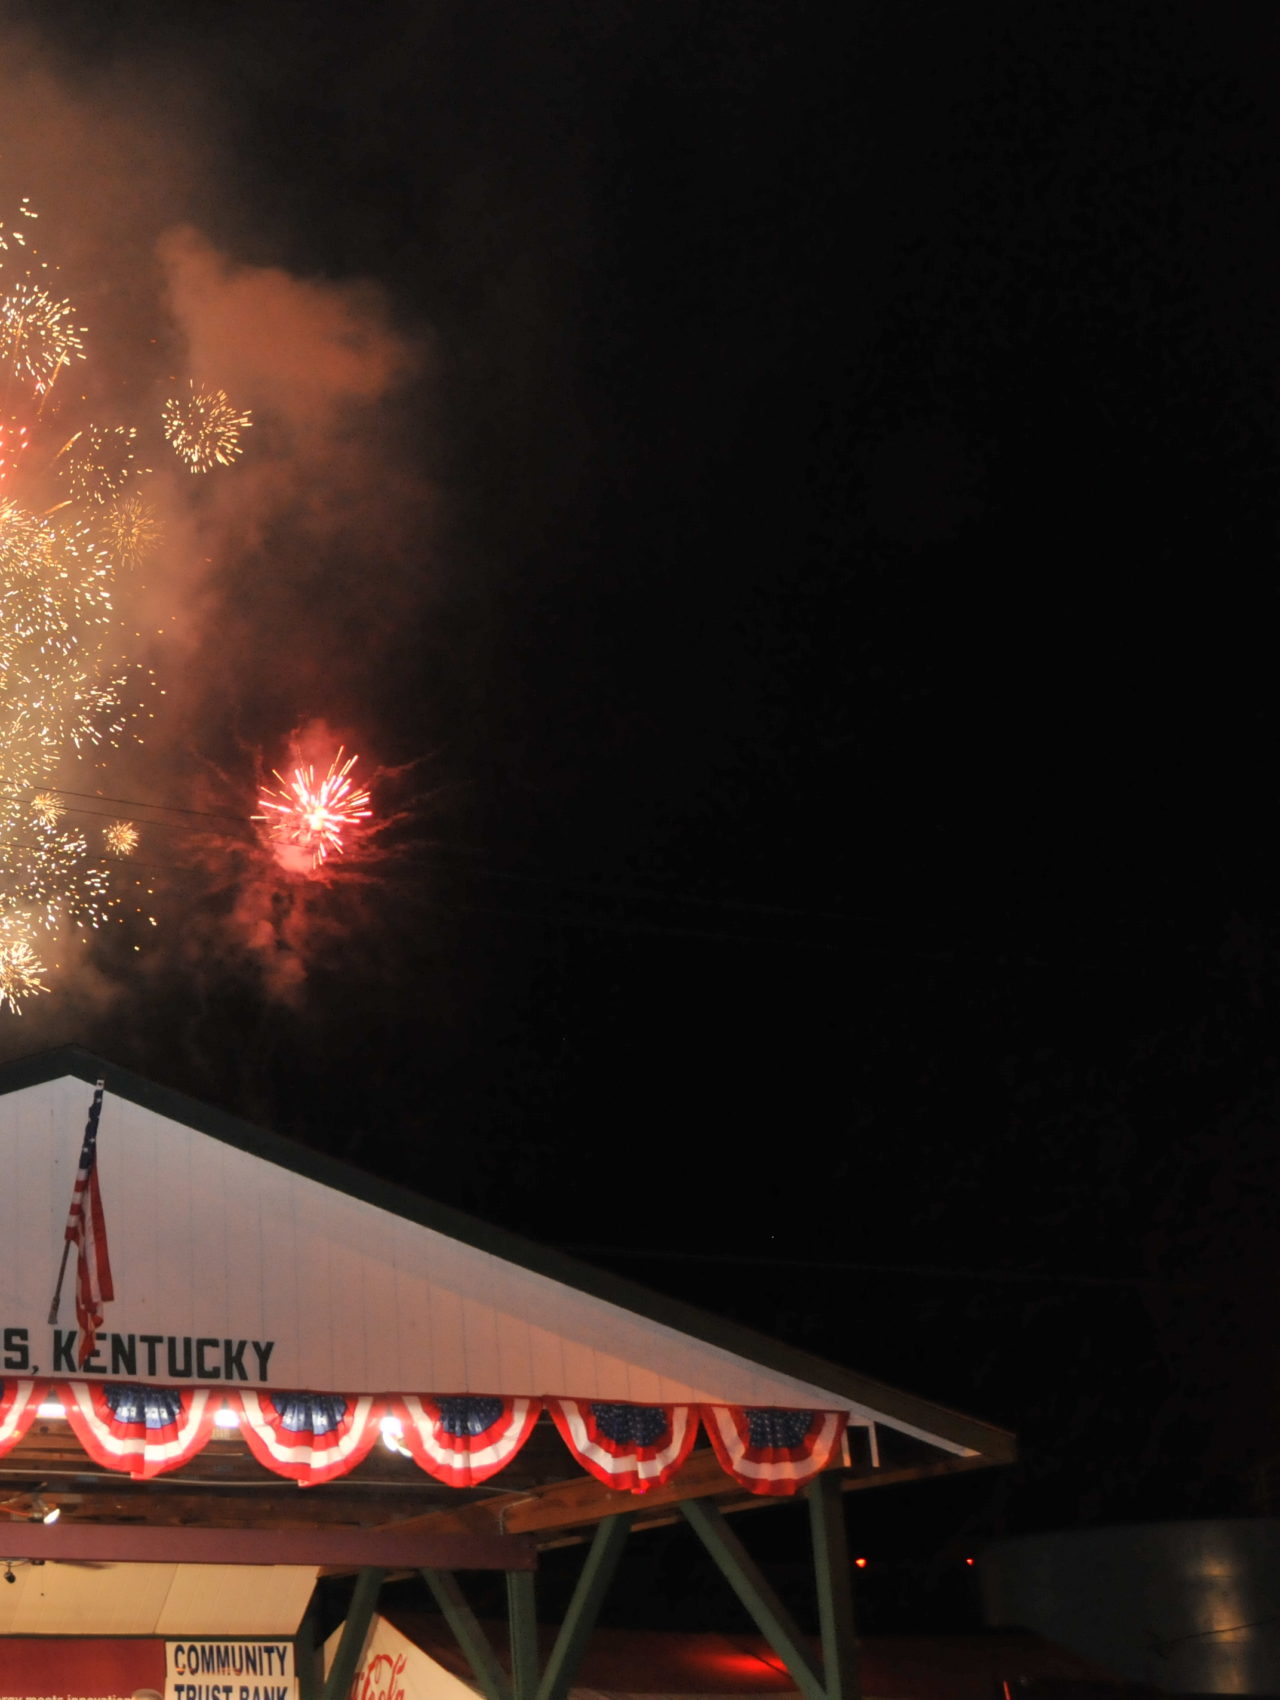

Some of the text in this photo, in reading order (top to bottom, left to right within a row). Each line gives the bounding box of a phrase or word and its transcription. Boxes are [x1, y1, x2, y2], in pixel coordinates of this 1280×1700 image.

[53, 1328, 275, 1382] KENTUCKY
[173, 1644, 288, 1676] COMMUNITY
[173, 1684, 233, 1700] TRUST
